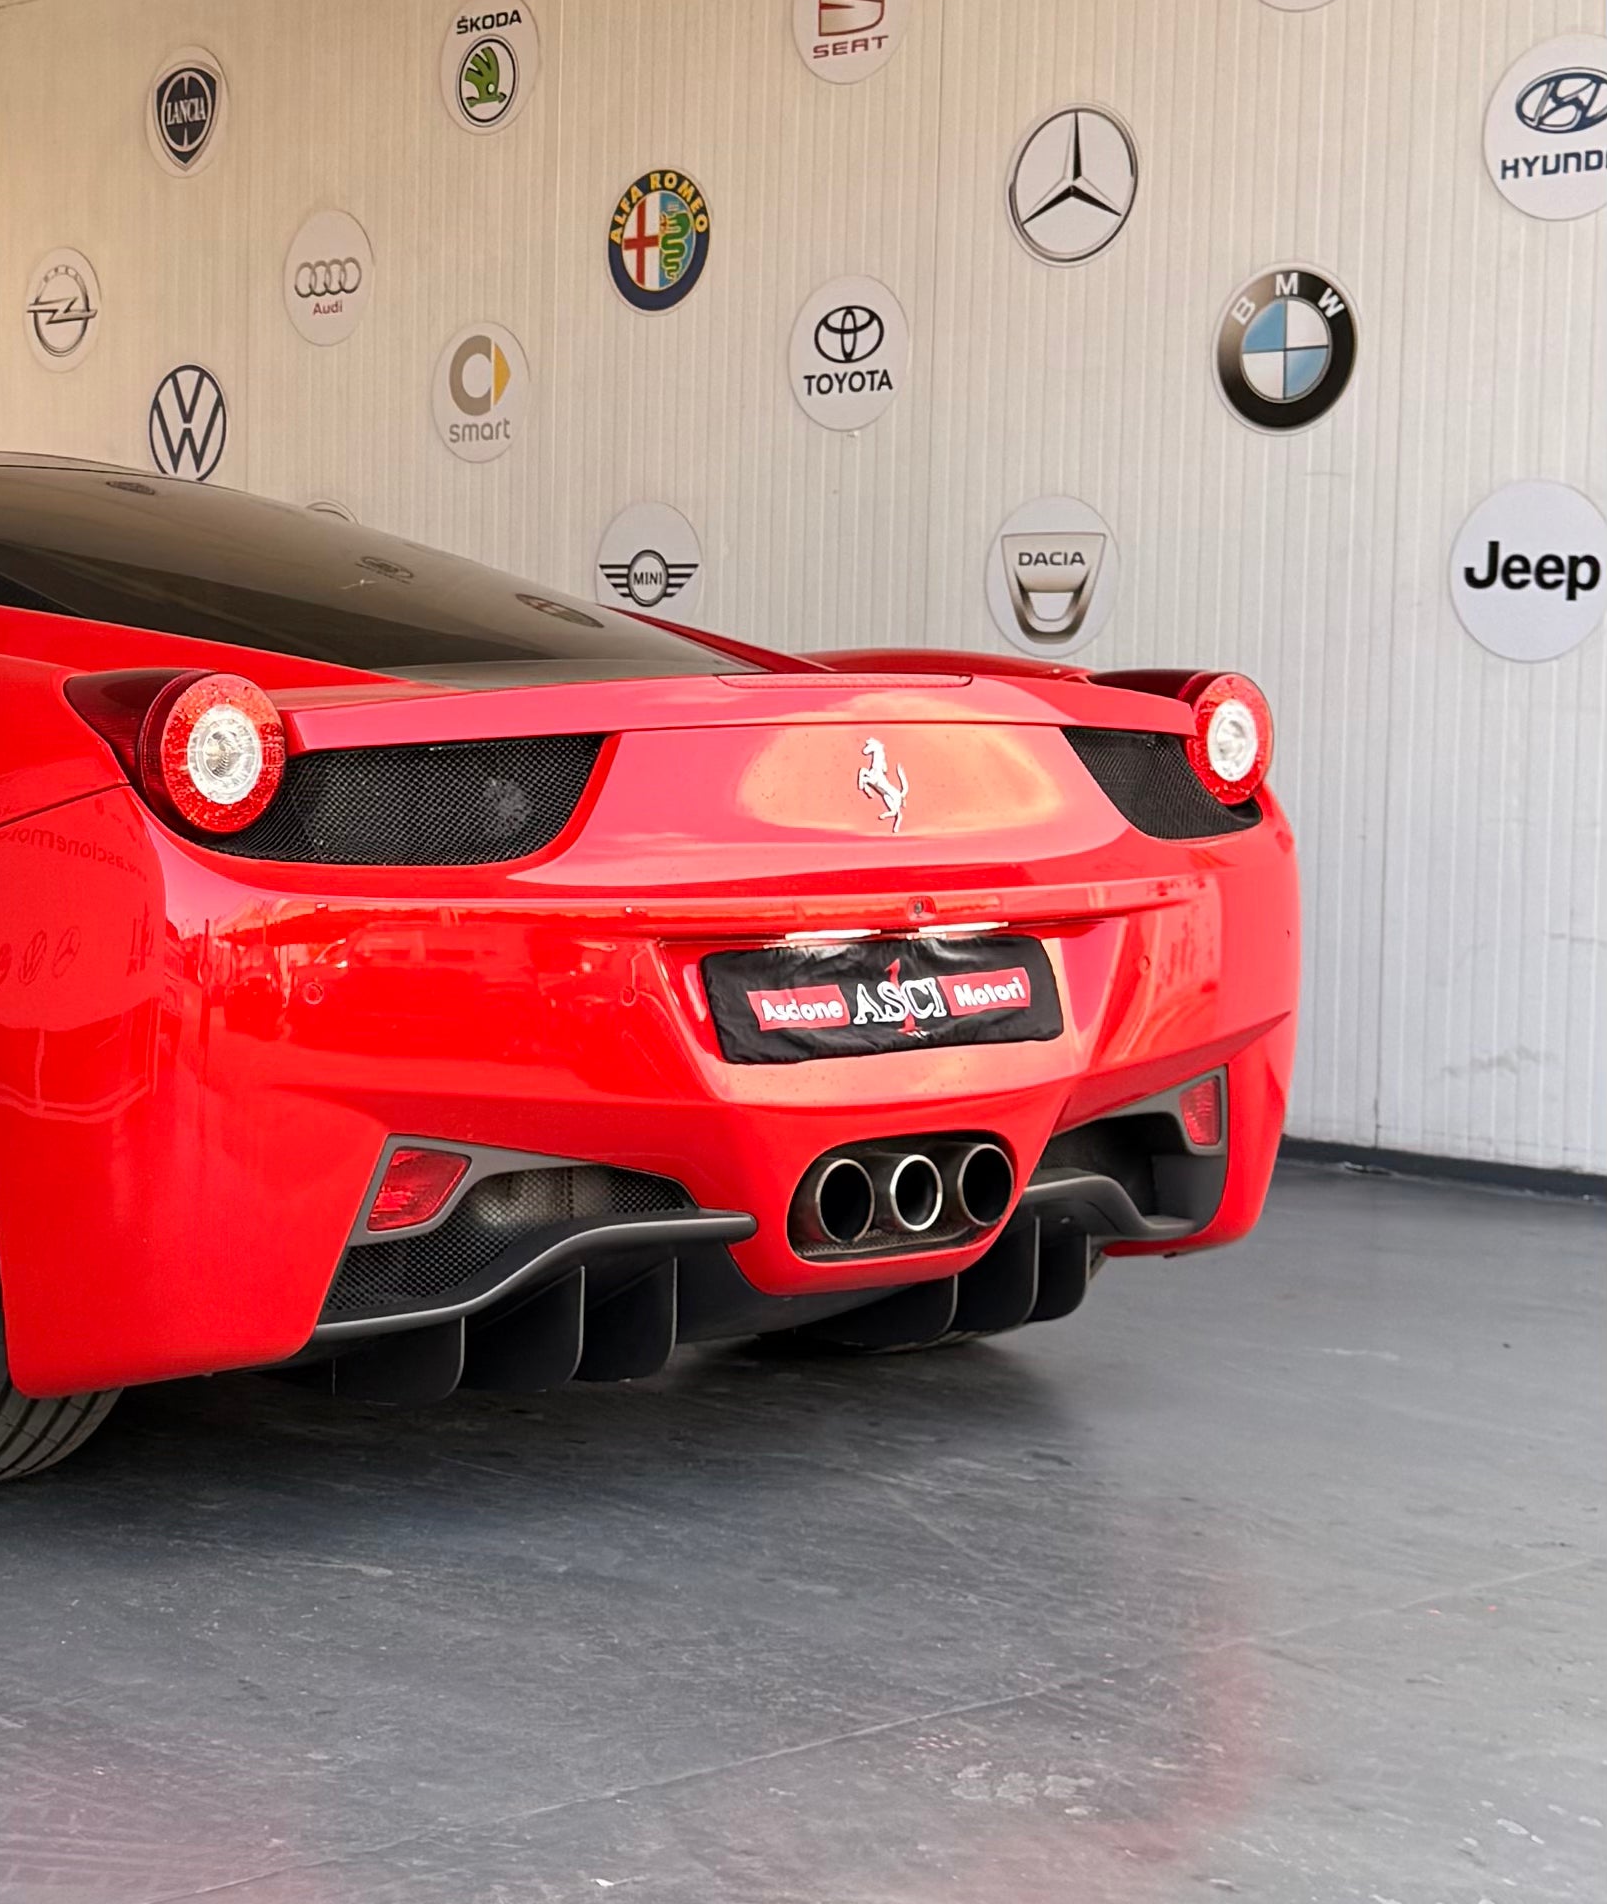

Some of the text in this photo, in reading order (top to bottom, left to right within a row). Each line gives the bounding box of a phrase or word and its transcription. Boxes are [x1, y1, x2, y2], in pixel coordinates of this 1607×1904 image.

[456, 9, 522, 35] ŠKODA
[813, 35, 889, 59] SEAT
[166, 97, 206, 126] LANCIA
[1501, 149, 1607, 180] HYUND
[610, 172, 709, 245] ALFA ROMEO
[313, 300, 343, 315] Audi
[1231, 272, 1345, 325] BMW
[803, 368, 893, 396] TOYOTA
[449, 417, 511, 443] smart
[1018, 551, 1086, 566] DACIA
[1464, 540, 1601, 601] Jeep
[633, 571, 662, 586] MINI
[760, 975, 1028, 1025] Ascione ASCI Motori
